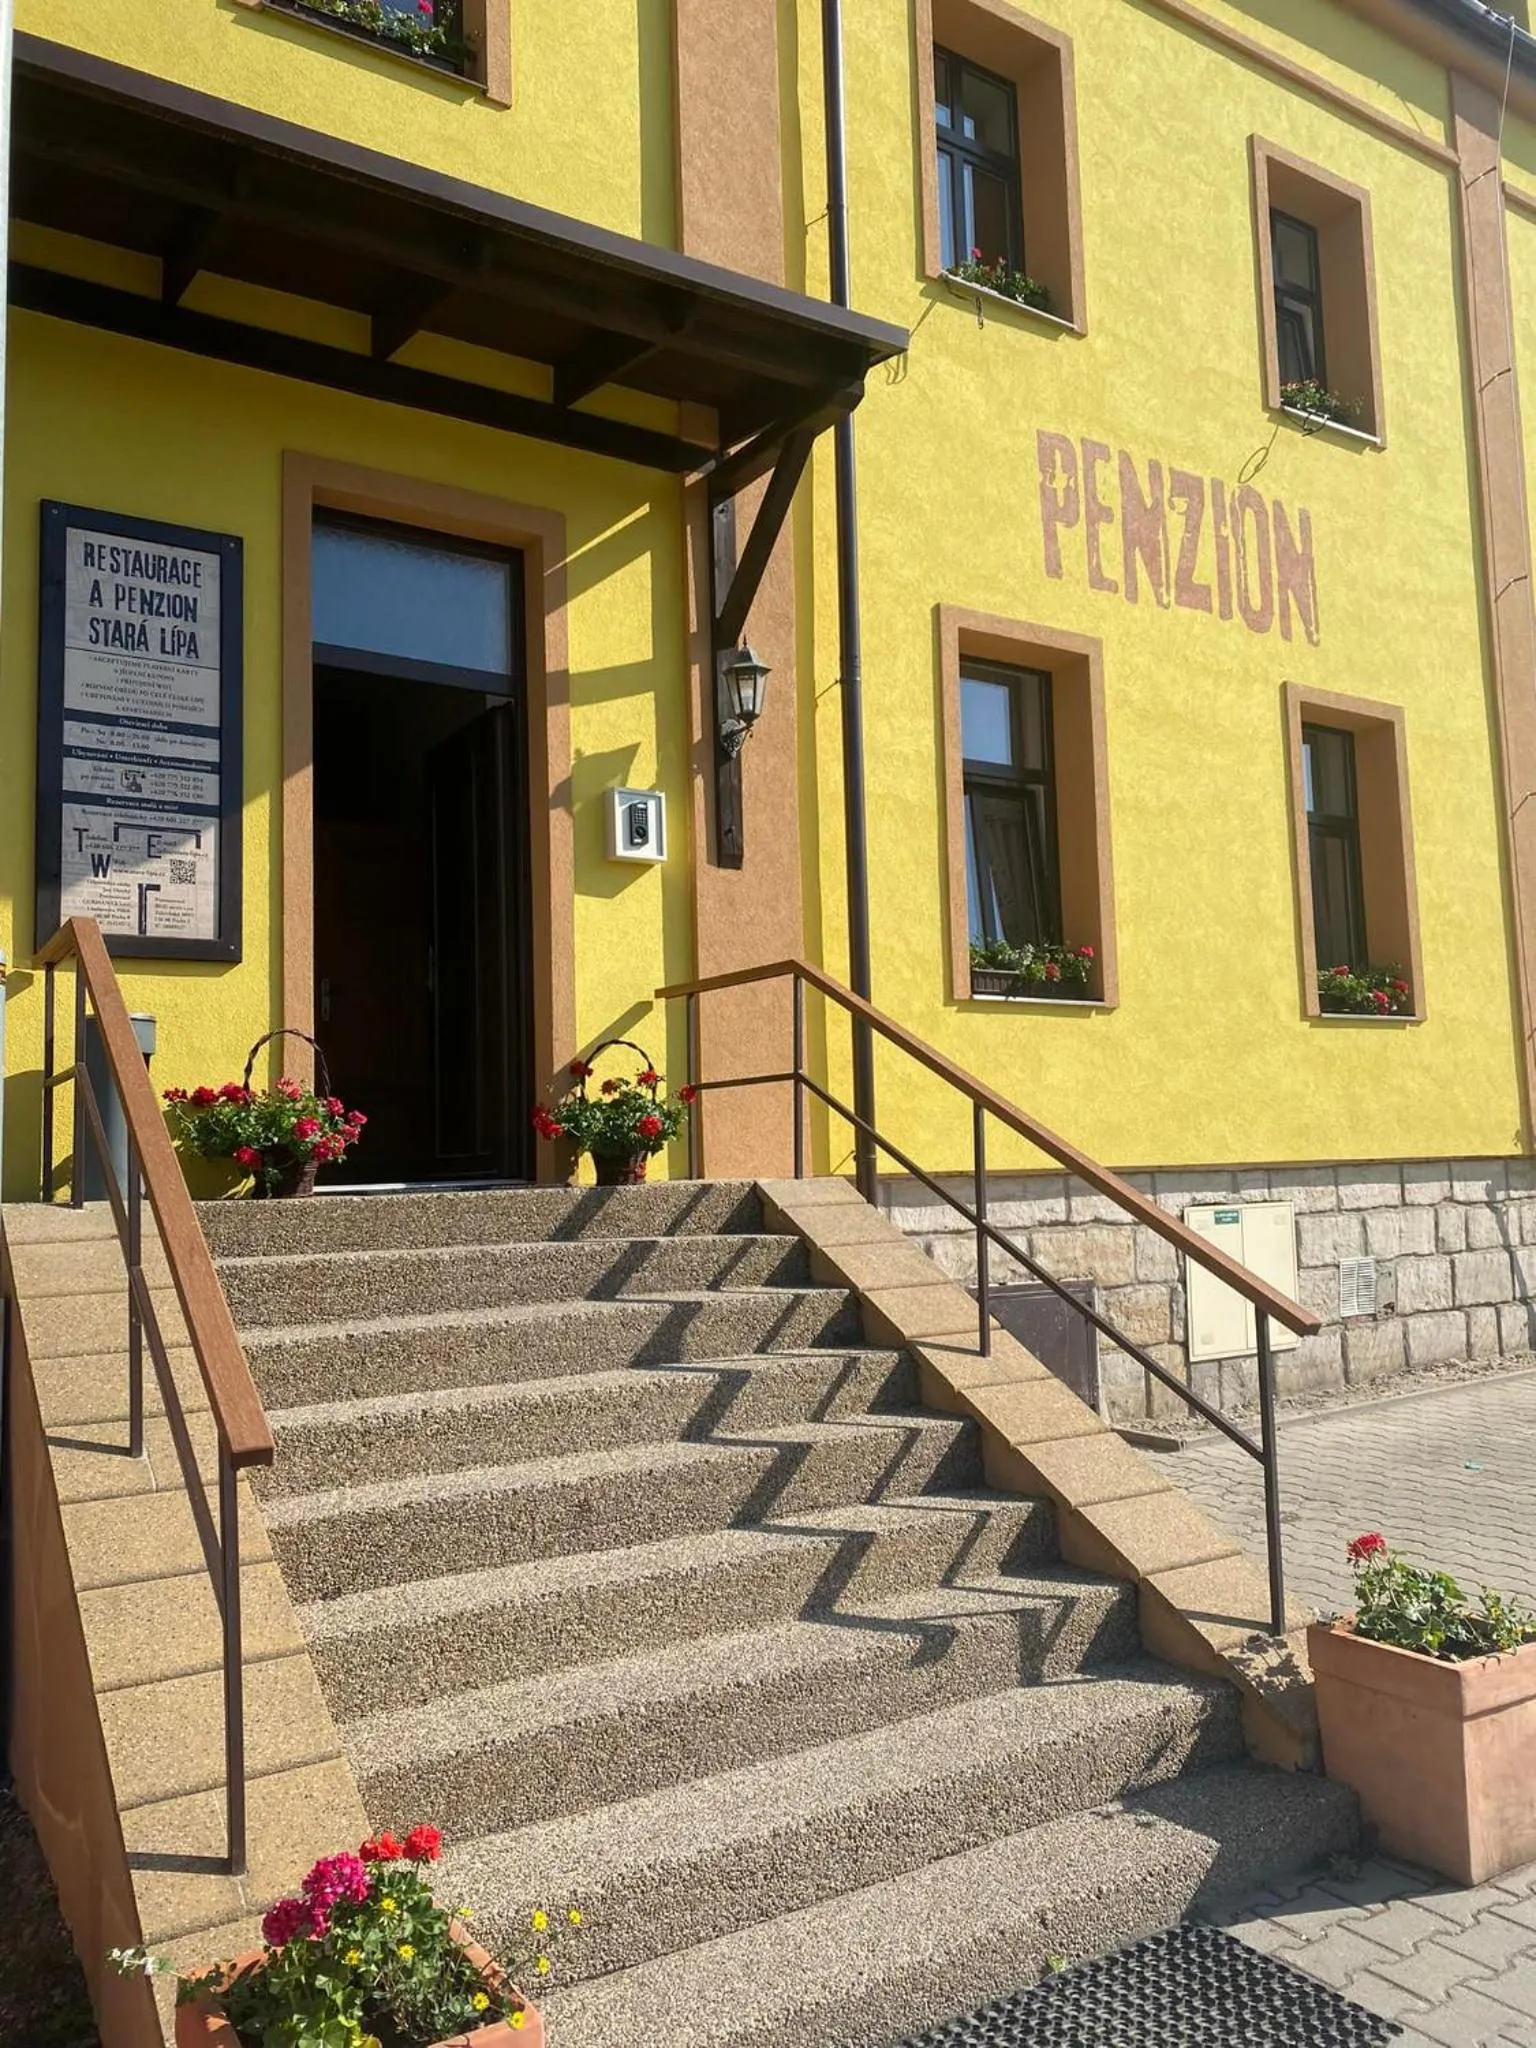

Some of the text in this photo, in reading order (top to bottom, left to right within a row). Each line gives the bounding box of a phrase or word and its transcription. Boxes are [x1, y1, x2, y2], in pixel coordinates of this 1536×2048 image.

[1036, 429, 1320, 647] PENZION
[84, 541, 202, 588] RESTAURACE
[89, 579, 198, 623] A PENZION
[89, 616, 199, 659] STARÁ LÍPA
[91, 854, 111, 878] W
